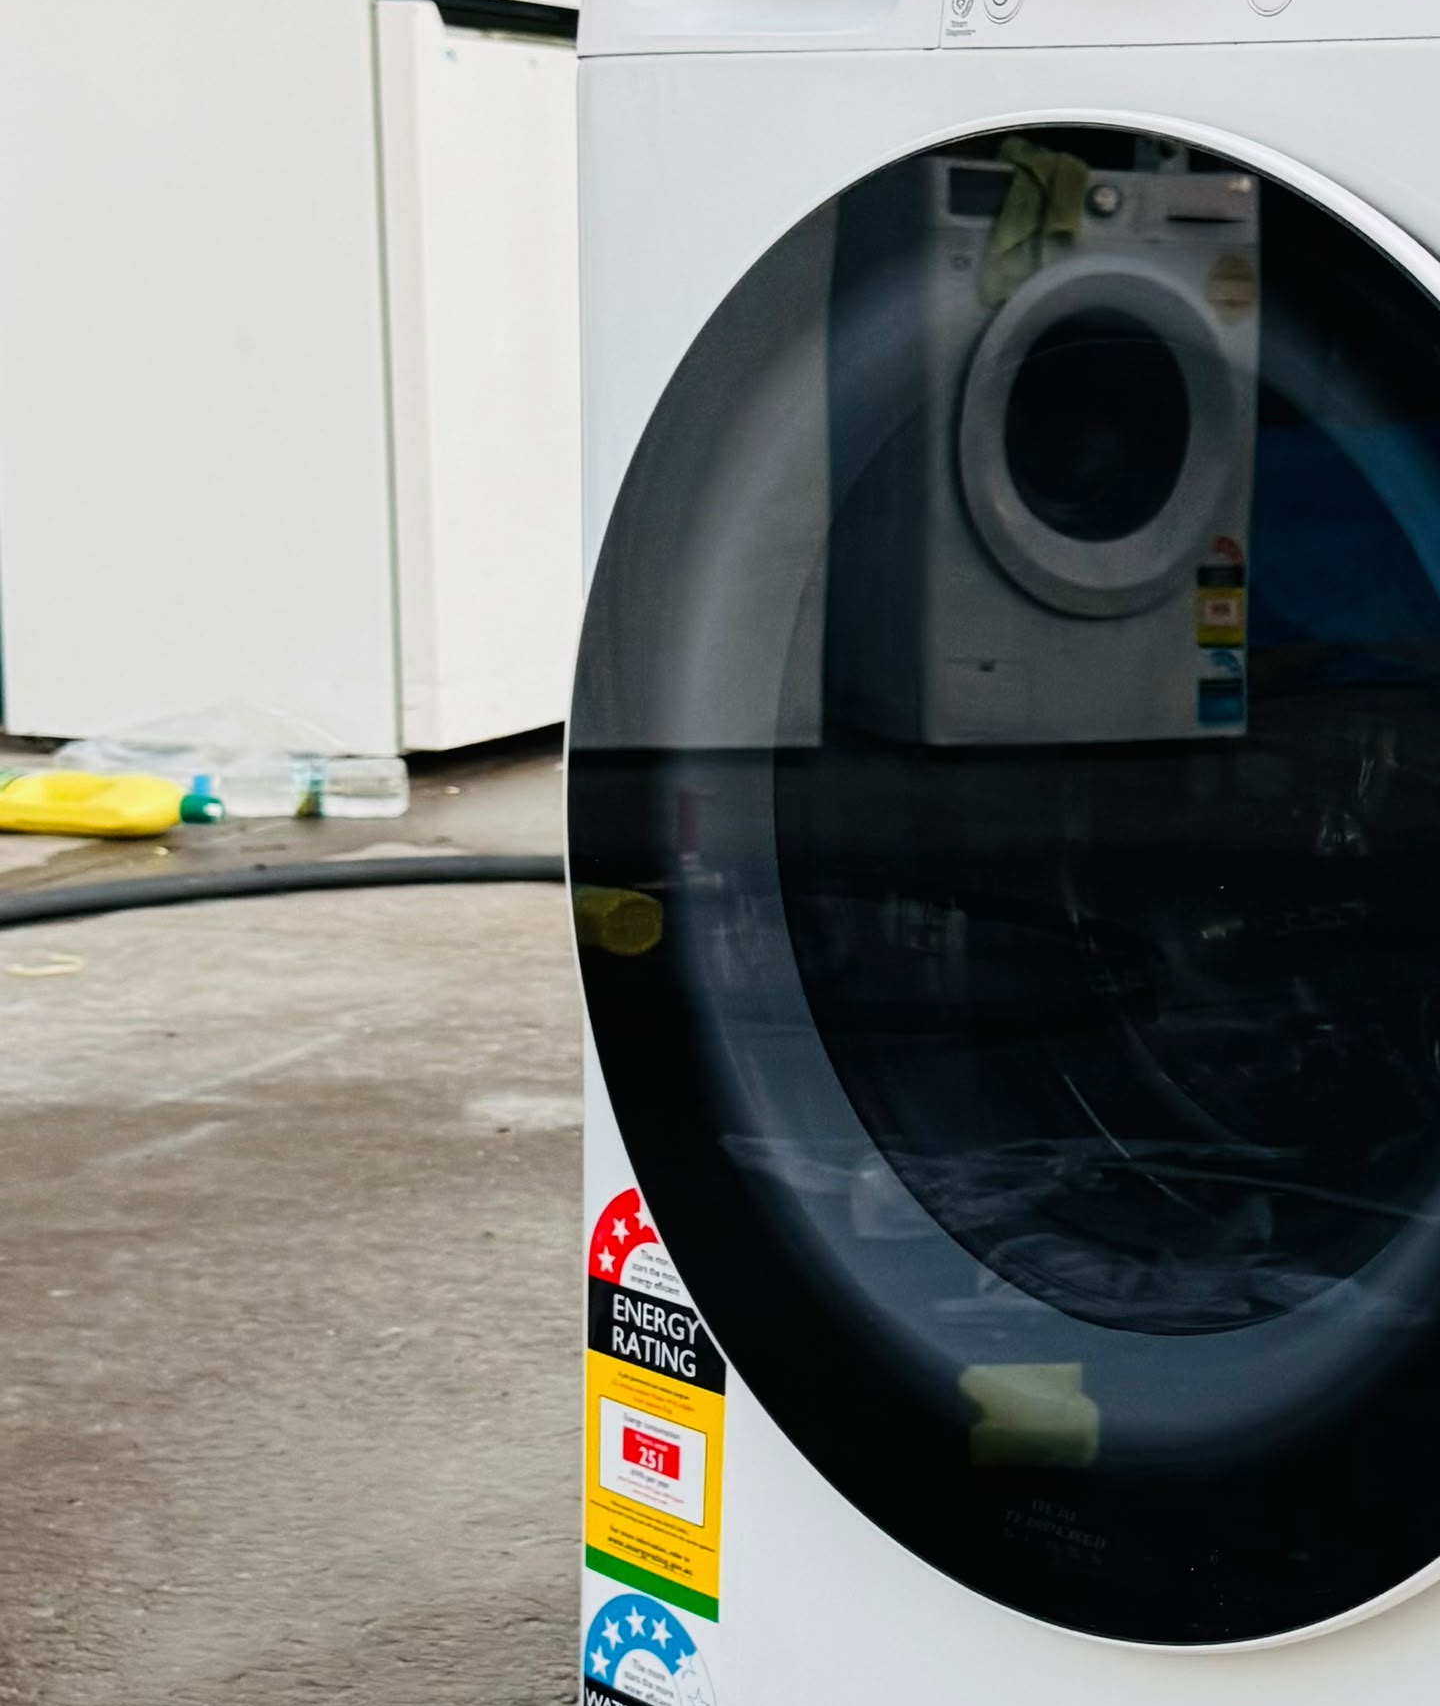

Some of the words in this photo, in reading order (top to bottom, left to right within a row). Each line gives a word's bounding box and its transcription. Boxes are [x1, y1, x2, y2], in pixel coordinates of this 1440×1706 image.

[613, 1293, 700, 1344] ENERGY
[612, 1325, 696, 1377] RATING
[638, 1447, 664, 1472] 251
